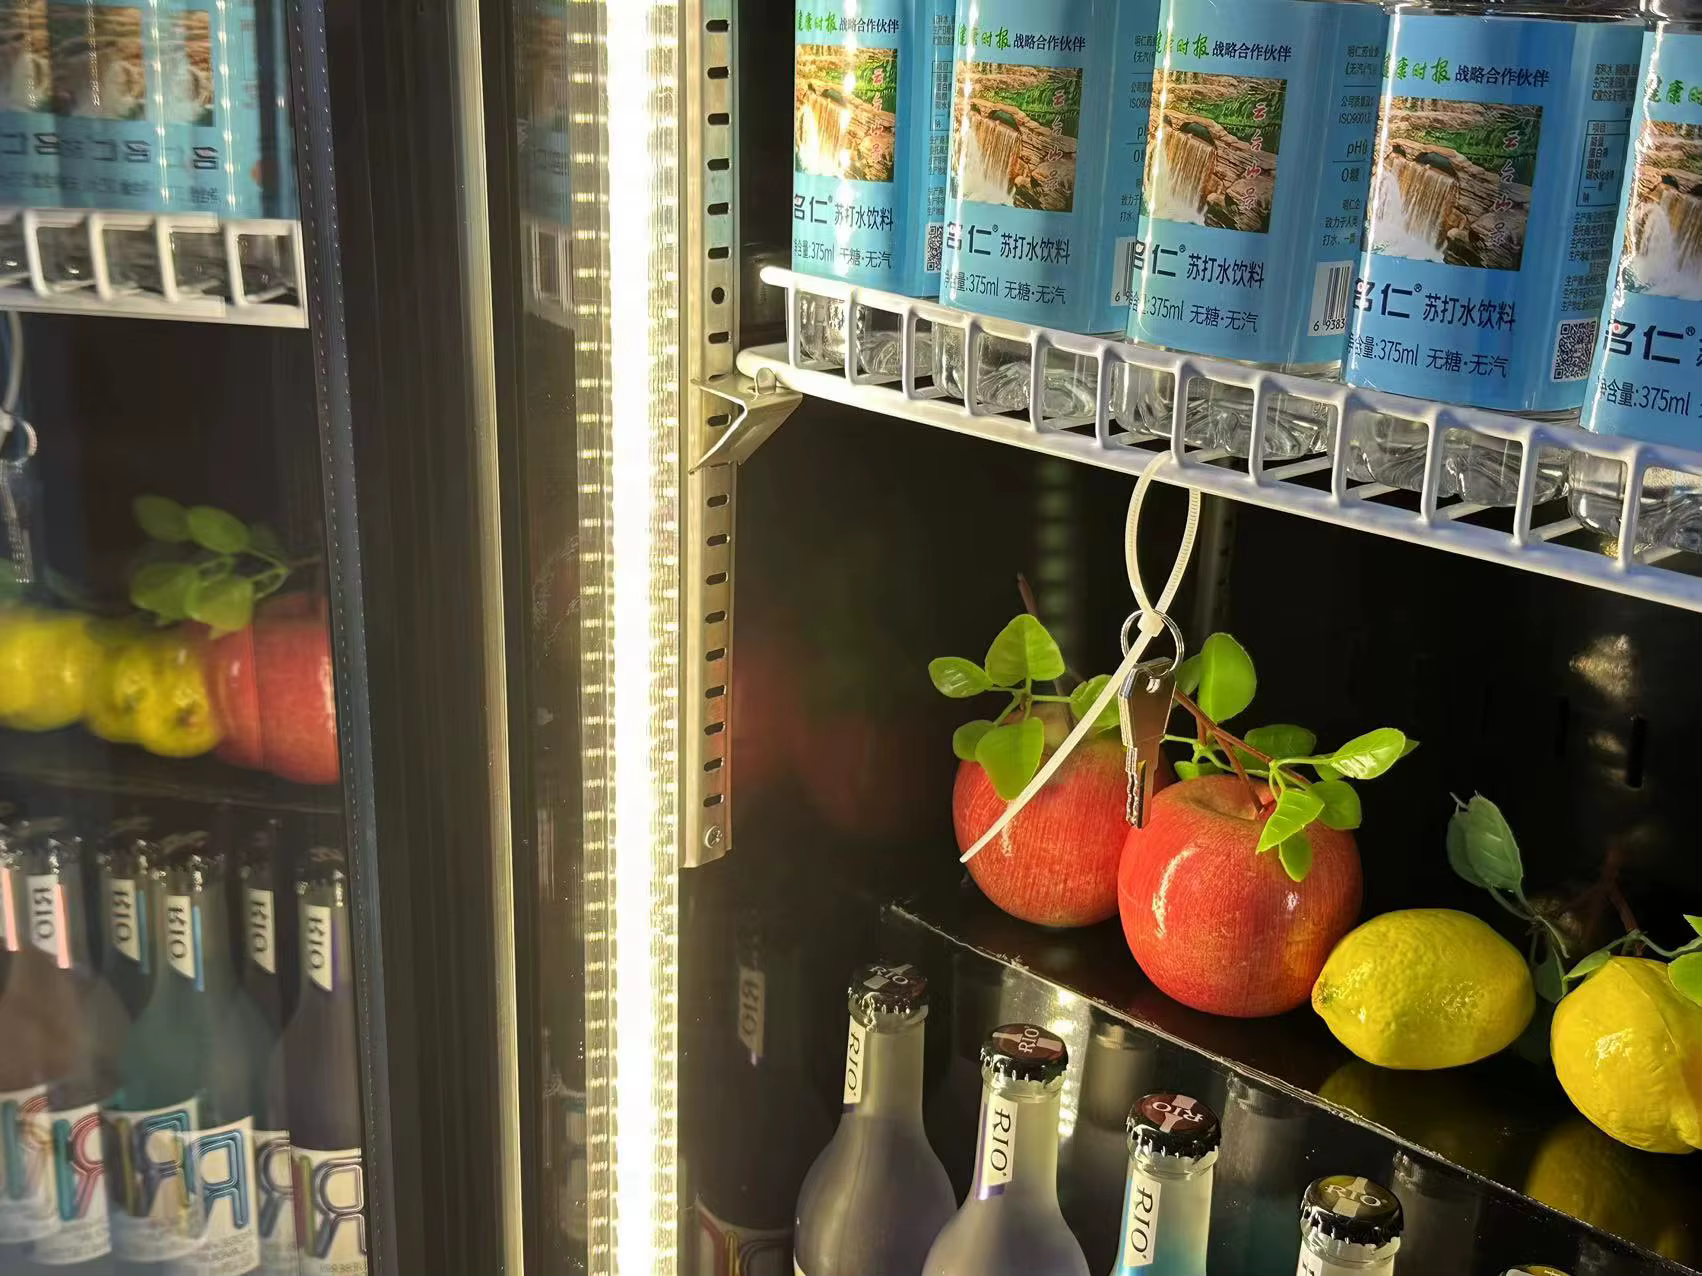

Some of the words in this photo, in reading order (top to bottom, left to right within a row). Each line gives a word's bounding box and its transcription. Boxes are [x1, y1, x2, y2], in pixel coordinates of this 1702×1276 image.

[839, 17, 900, 34] 战略合作伙伴
[1013, 33, 1086, 52] 战略合作伙伴
[1212, 39, 1292, 63] 战略合作伙伴
[1455, 64, 1550, 88] 战略合作伙伴
[834, 202, 894, 232] 苏打水饮料
[1000, 232, 1071, 264] 苏打水饮料
[1186, 253, 1264, 289] 苏打水饮料
[1423, 293, 1516, 332] 苏打水饮料
[1018, 1027, 1040, 1054] RIO
[847, 1031, 860, 1094] RIO
[1151, 1101, 1204, 1123] RIO
[990, 1108, 1011, 1175] RIO
[1325, 1184, 1388, 1207] RIO
[1131, 1184, 1153, 1258] RIO
